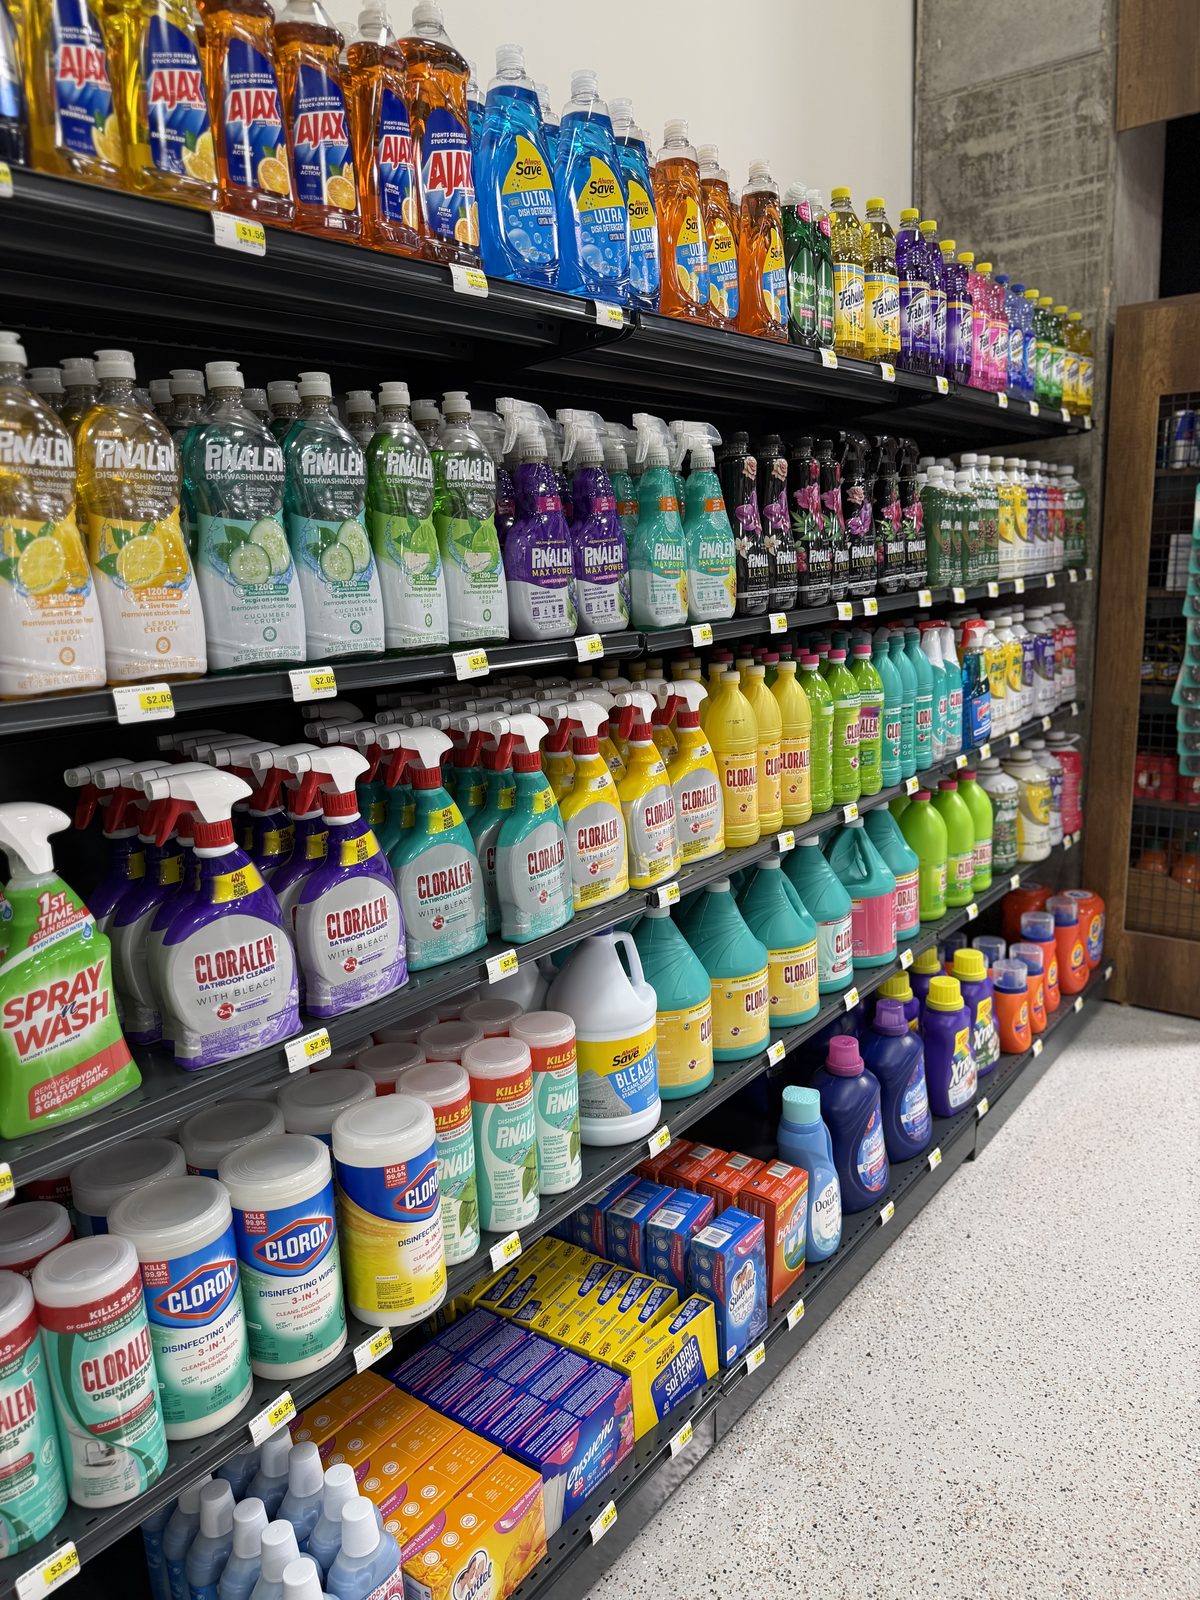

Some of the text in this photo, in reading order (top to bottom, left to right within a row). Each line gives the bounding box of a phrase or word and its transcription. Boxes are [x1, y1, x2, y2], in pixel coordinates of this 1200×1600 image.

[57, 45, 109, 88] AJAX
[152, 70, 203, 110] AJAX
[228, 90, 281, 128] AJAX
[297, 111, 347, 149] AJAX
[381, 136, 413, 169] AJAX
[428, 151, 472, 198] AJAX
[516, 161, 543, 177] Save
[589, 181, 615, 195] Save
[522, 190, 551, 206] ULTRA
[518, 208, 531, 217] DISH
[595, 208, 624, 223] ULTRA
[629, 202, 649, 217] Save
[241, 227, 265, 241] $1.59
[591, 222, 625, 234] DISH DETERGENT
[714, 238, 732, 251] Save
[95, 471, 160, 482] DISHWASHING
[206, 472, 285, 482] DISHWASHING LIQUID
[303, 477, 350, 486] DISHWASHING
[585, 564, 624, 575] MAX POWER
[698, 557, 735, 567] MAX POWER
[532, 567, 573, 577] MAX POWER
[147, 587, 168, 597] 1200
[253, 583, 274, 592] 1200
[341, 580, 358, 588] 1200
[121, 610, 148, 619] Removes
[231, 604, 258, 613] Removes
[243, 612, 291, 620] CUCUMBER
[315, 675, 336, 686] $2.09
[146, 694, 172, 705] $2.09
[681, 784, 718, 812] CLORALEN
[684, 808, 719, 823] WITH BLEACH
[577, 818, 618, 851] CLORALEN
[527, 838, 566, 876] CLORALEN
[579, 845, 620, 864] WITH BLEACH
[231, 870, 246, 884] 40%
[417, 860, 473, 900] CLORALEN
[419, 884, 473, 907] BATHROOM CLEANER
[528, 881, 546, 894] WITH
[39, 891, 66, 911] 1ST
[418, 896, 474, 918] WITH BLEACH
[38, 904, 75, 929] TIME
[326, 895, 388, 941] CLORALEN
[32, 910, 86, 944] STAIN REMOVAL
[32, 939, 48, 952] EVEN
[55, 928, 70, 942] COLD
[70, 921, 83, 935] WATER
[329, 922, 388, 947] BATHROOM CLEANER
[327, 932, 389, 961] WITH BLEACH
[194, 934, 276, 984] CLORALEN
[198, 964, 276, 992] BATHROOM CLEANER
[3, 959, 104, 1029] SPRAY
[196, 976, 277, 1007] WITH BLEACH
[13, 989, 110, 1056] WASH
[20, 1033, 81, 1063] LAUNDRY STAIN REMOVER
[309, 1037, 330, 1051] $2.89
[547, 1052, 571, 1066] KILLS
[612, 1049, 640, 1067] Save
[59, 1063, 103, 1097] EVERYDAY
[615, 1053, 654, 1090] BLEACH
[34, 1074, 70, 1097] REMOVES
[35, 1067, 109, 1113] & GREASY STAINS
[496, 1083, 524, 1098] KILLS
[385, 1164, 406, 1175] KILLS
[386, 1171, 407, 1182] 99.9%
[244, 1212, 265, 1221] KILLS
[245, 1218, 266, 1227] 99.9%
[264, 1220, 327, 1264] CLOROX
[144, 1262, 167, 1272] KILLS
[144, 1270, 168, 1279] 99.9%
[167, 1263, 233, 1315] CLOROX
[258, 1262, 337, 1299] DISINFECTING WIPES
[275, 1292, 332, 1318] CLEANS, DEODORIZES
[291, 1287, 320, 1307] 3-IN-1
[89, 1300, 119, 1321] KILLS
[293, 1304, 321, 1321] FRESHENS
[161, 1306, 243, 1355] DISINFECTING WIPES
[305, 1332, 314, 1341] 75
[578, 1332, 592, 1346] Save
[197, 1336, 227, 1357] 3-IN-1
[374, 1334, 391, 1351] $6.29
[598, 1342, 612, 1356] Save
[80, 1325, 152, 1394] CLORALEN
[181, 1339, 239, 1373] CLEANS, DEODORIZES
[200, 1354, 229, 1373] FRESHENS
[622, 1351, 637, 1364] Save
[656, 1346, 676, 1370] Save
[671, 1337, 698, 1374] FABRIC
[92, 1358, 152, 1403] DISINFECTANT
[665, 1351, 700, 1397] SOFTENER
[115, 1378, 147, 1402] WIPES
[213, 1384, 223, 1394] 75
[273, 1399, 294, 1419] $6.29
[574, 1477, 585, 1490] 80
[50, 1551, 78, 1576] $3.39
